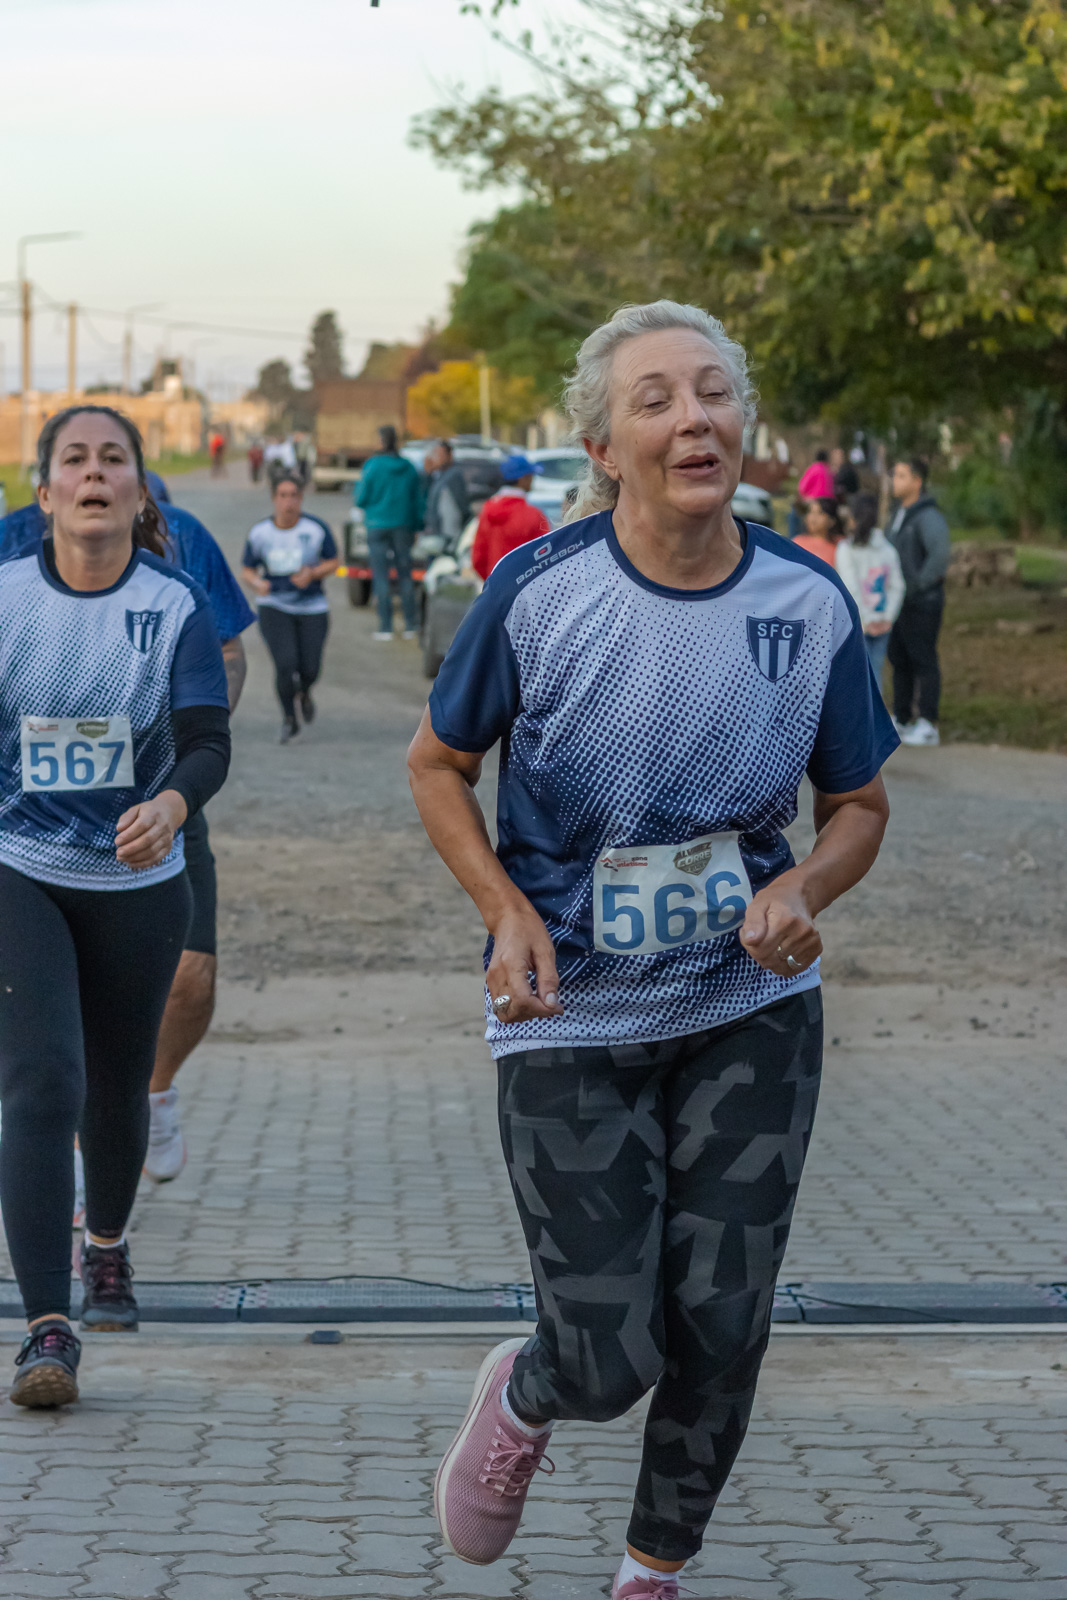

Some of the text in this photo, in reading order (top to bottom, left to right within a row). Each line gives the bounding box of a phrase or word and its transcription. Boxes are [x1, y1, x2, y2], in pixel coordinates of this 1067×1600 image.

[133, 613, 157, 624] SFC
[757, 623, 793, 638] SFC
[30, 741, 125, 787] 567
[677, 850, 711, 867] CORRE
[602, 871, 747, 950] 566
